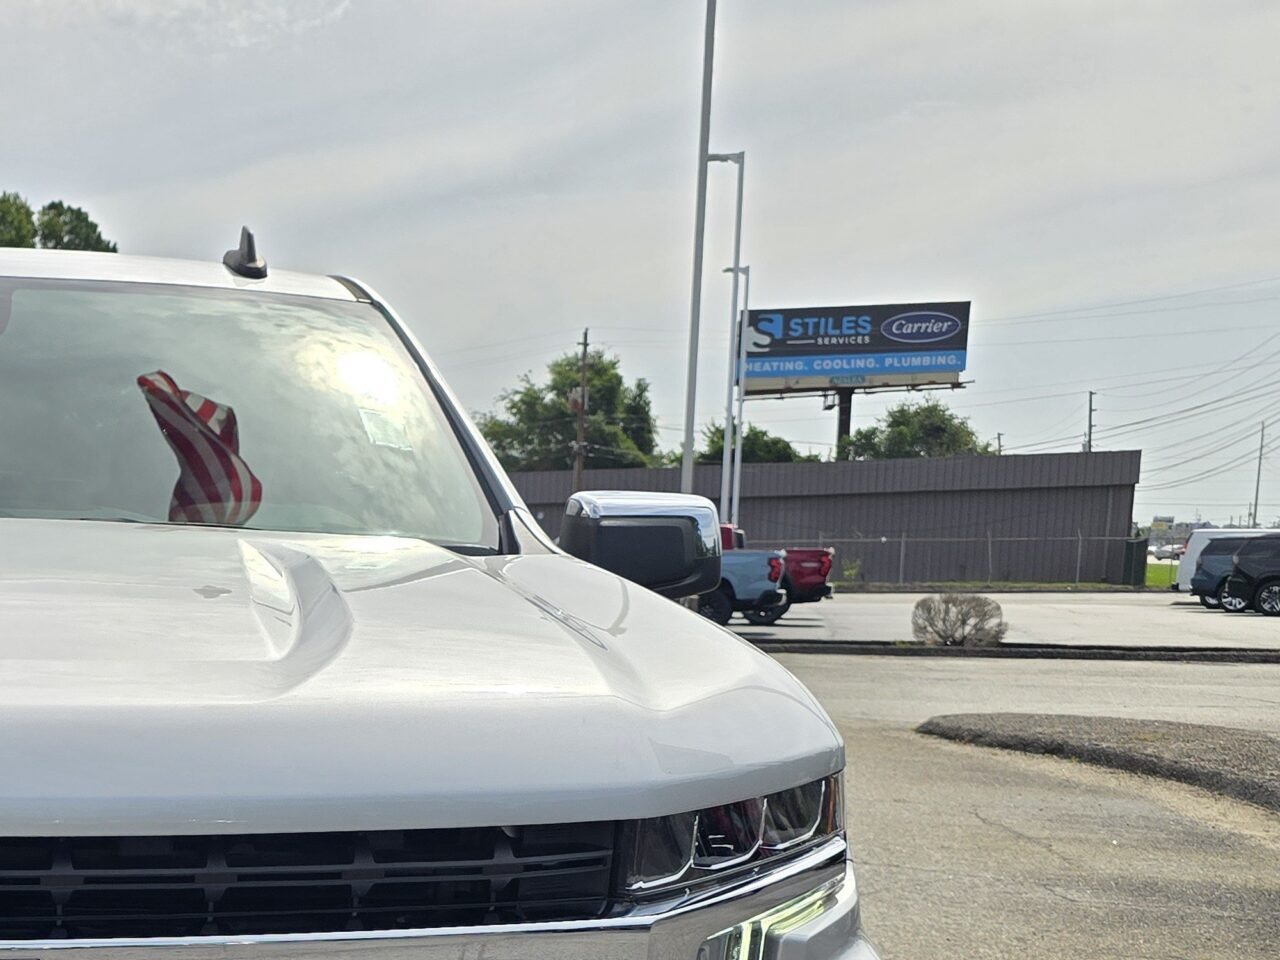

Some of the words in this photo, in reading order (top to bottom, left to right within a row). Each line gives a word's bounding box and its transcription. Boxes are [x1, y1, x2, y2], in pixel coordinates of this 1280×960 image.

[788, 315, 872, 337] STILES
[892, 318, 952, 334] Carrier
[817, 335, 870, 346] SERVICES
[812, 358, 880, 370] COOLING.
[884, 354, 961, 368] PLUMBING.
